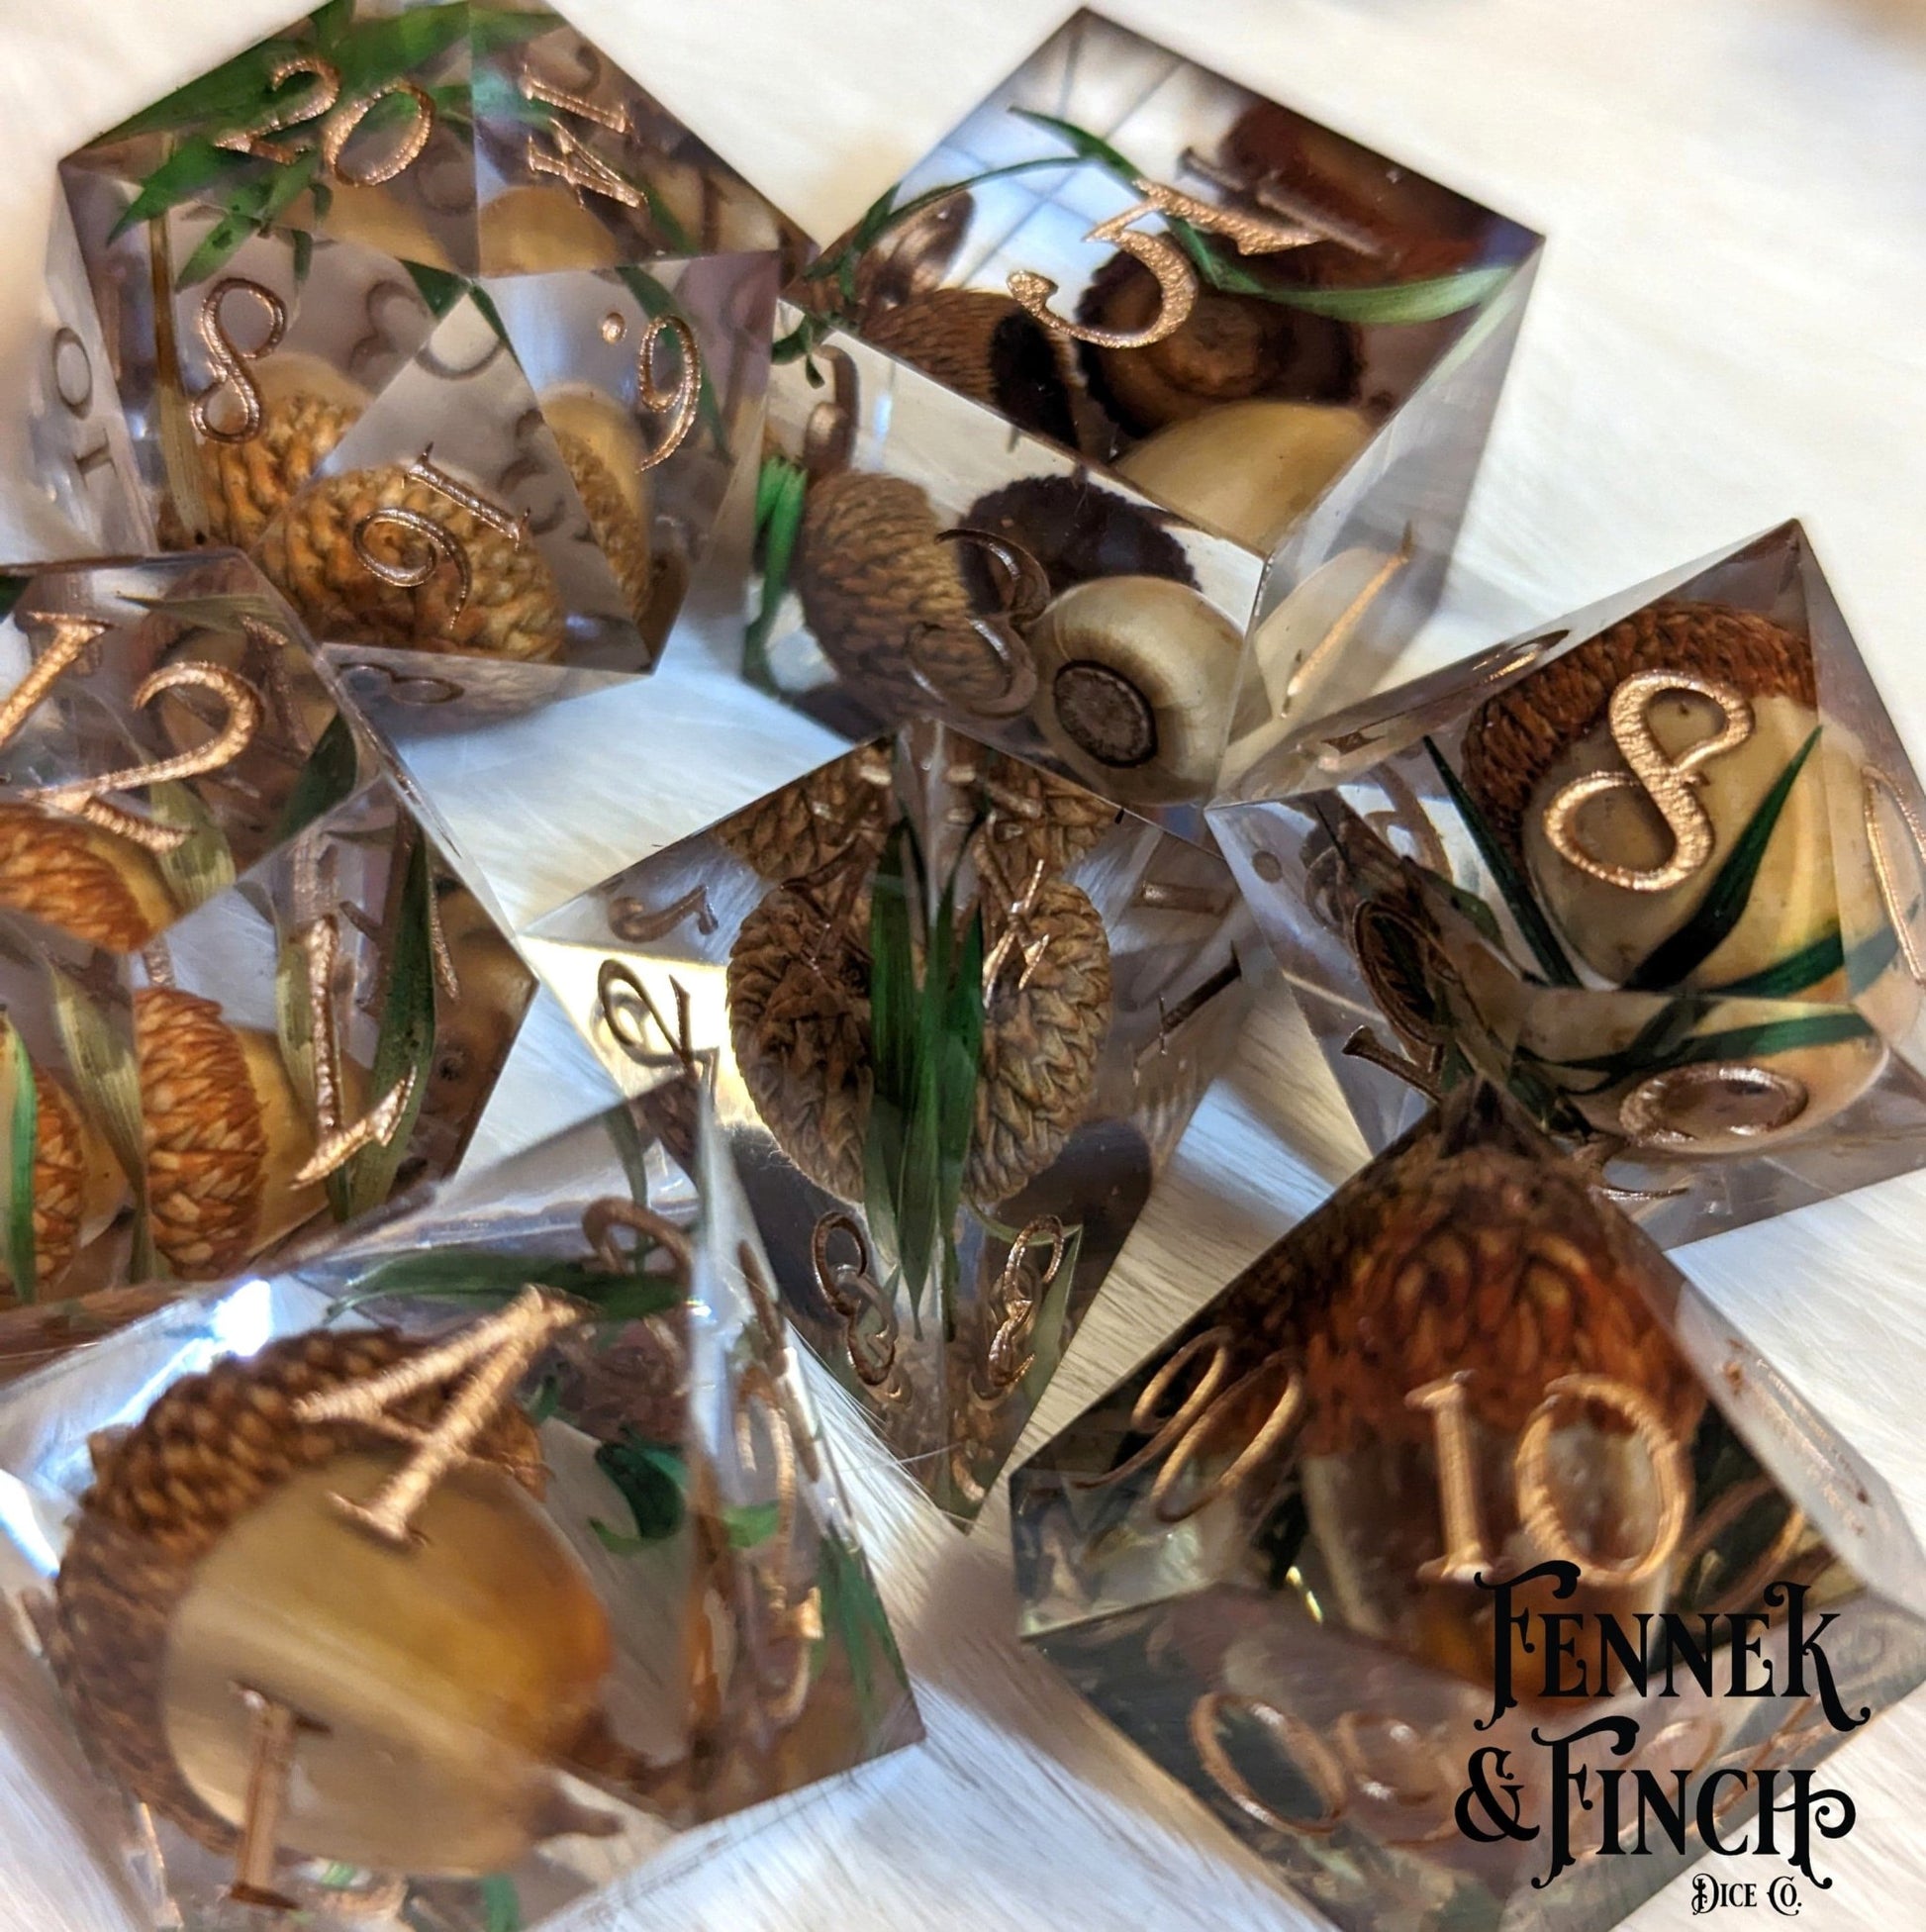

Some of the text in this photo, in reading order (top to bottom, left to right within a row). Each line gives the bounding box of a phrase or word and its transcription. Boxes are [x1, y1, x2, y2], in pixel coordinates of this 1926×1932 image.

[215, 56, 435, 188] 20
[524, 61, 649, 210] 14
[1007, 178, 1328, 349] 5
[190, 277, 287, 443] 8
[1544, 669, 1756, 890] 8
[292, 1283, 582, 1550] 4
[1403, 1370, 1694, 1584] 10
